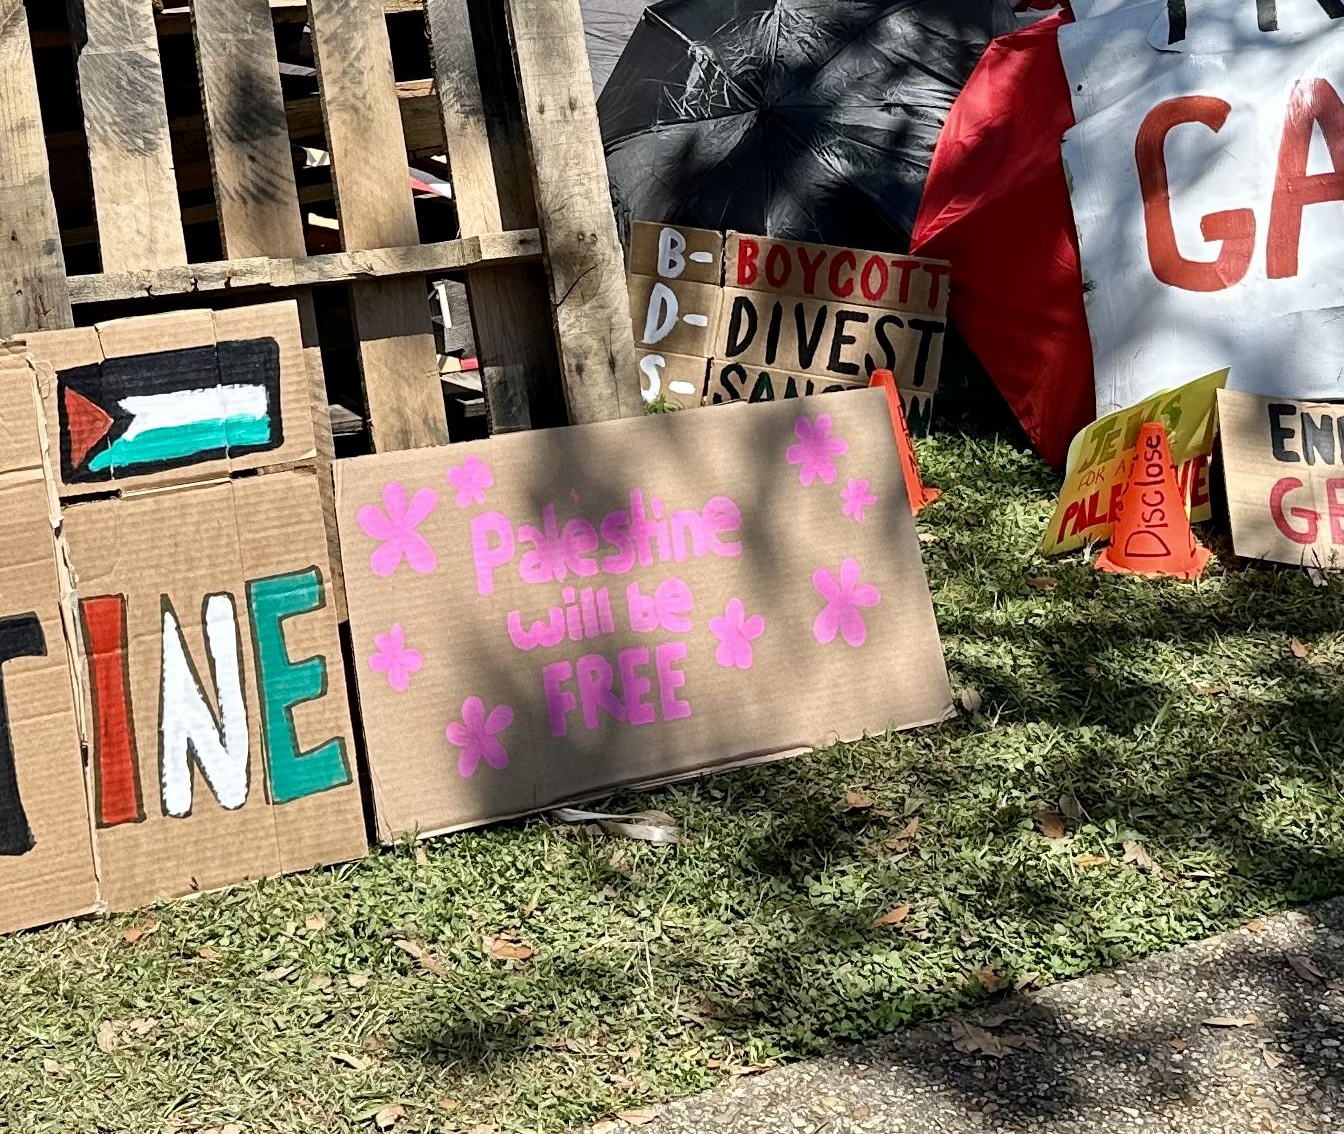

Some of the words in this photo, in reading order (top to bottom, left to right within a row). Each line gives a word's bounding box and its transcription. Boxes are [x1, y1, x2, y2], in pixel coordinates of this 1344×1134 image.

[737, 238, 950, 309] BOYCOTT
[725, 296, 945, 388] DIVEST
[470, 487, 743, 597] Palestine
[1125, 434, 1171, 558] Disclose
[508, 585, 613, 651] will
[627, 577, 694, 633] be
[543, 641, 692, 737] FREE
